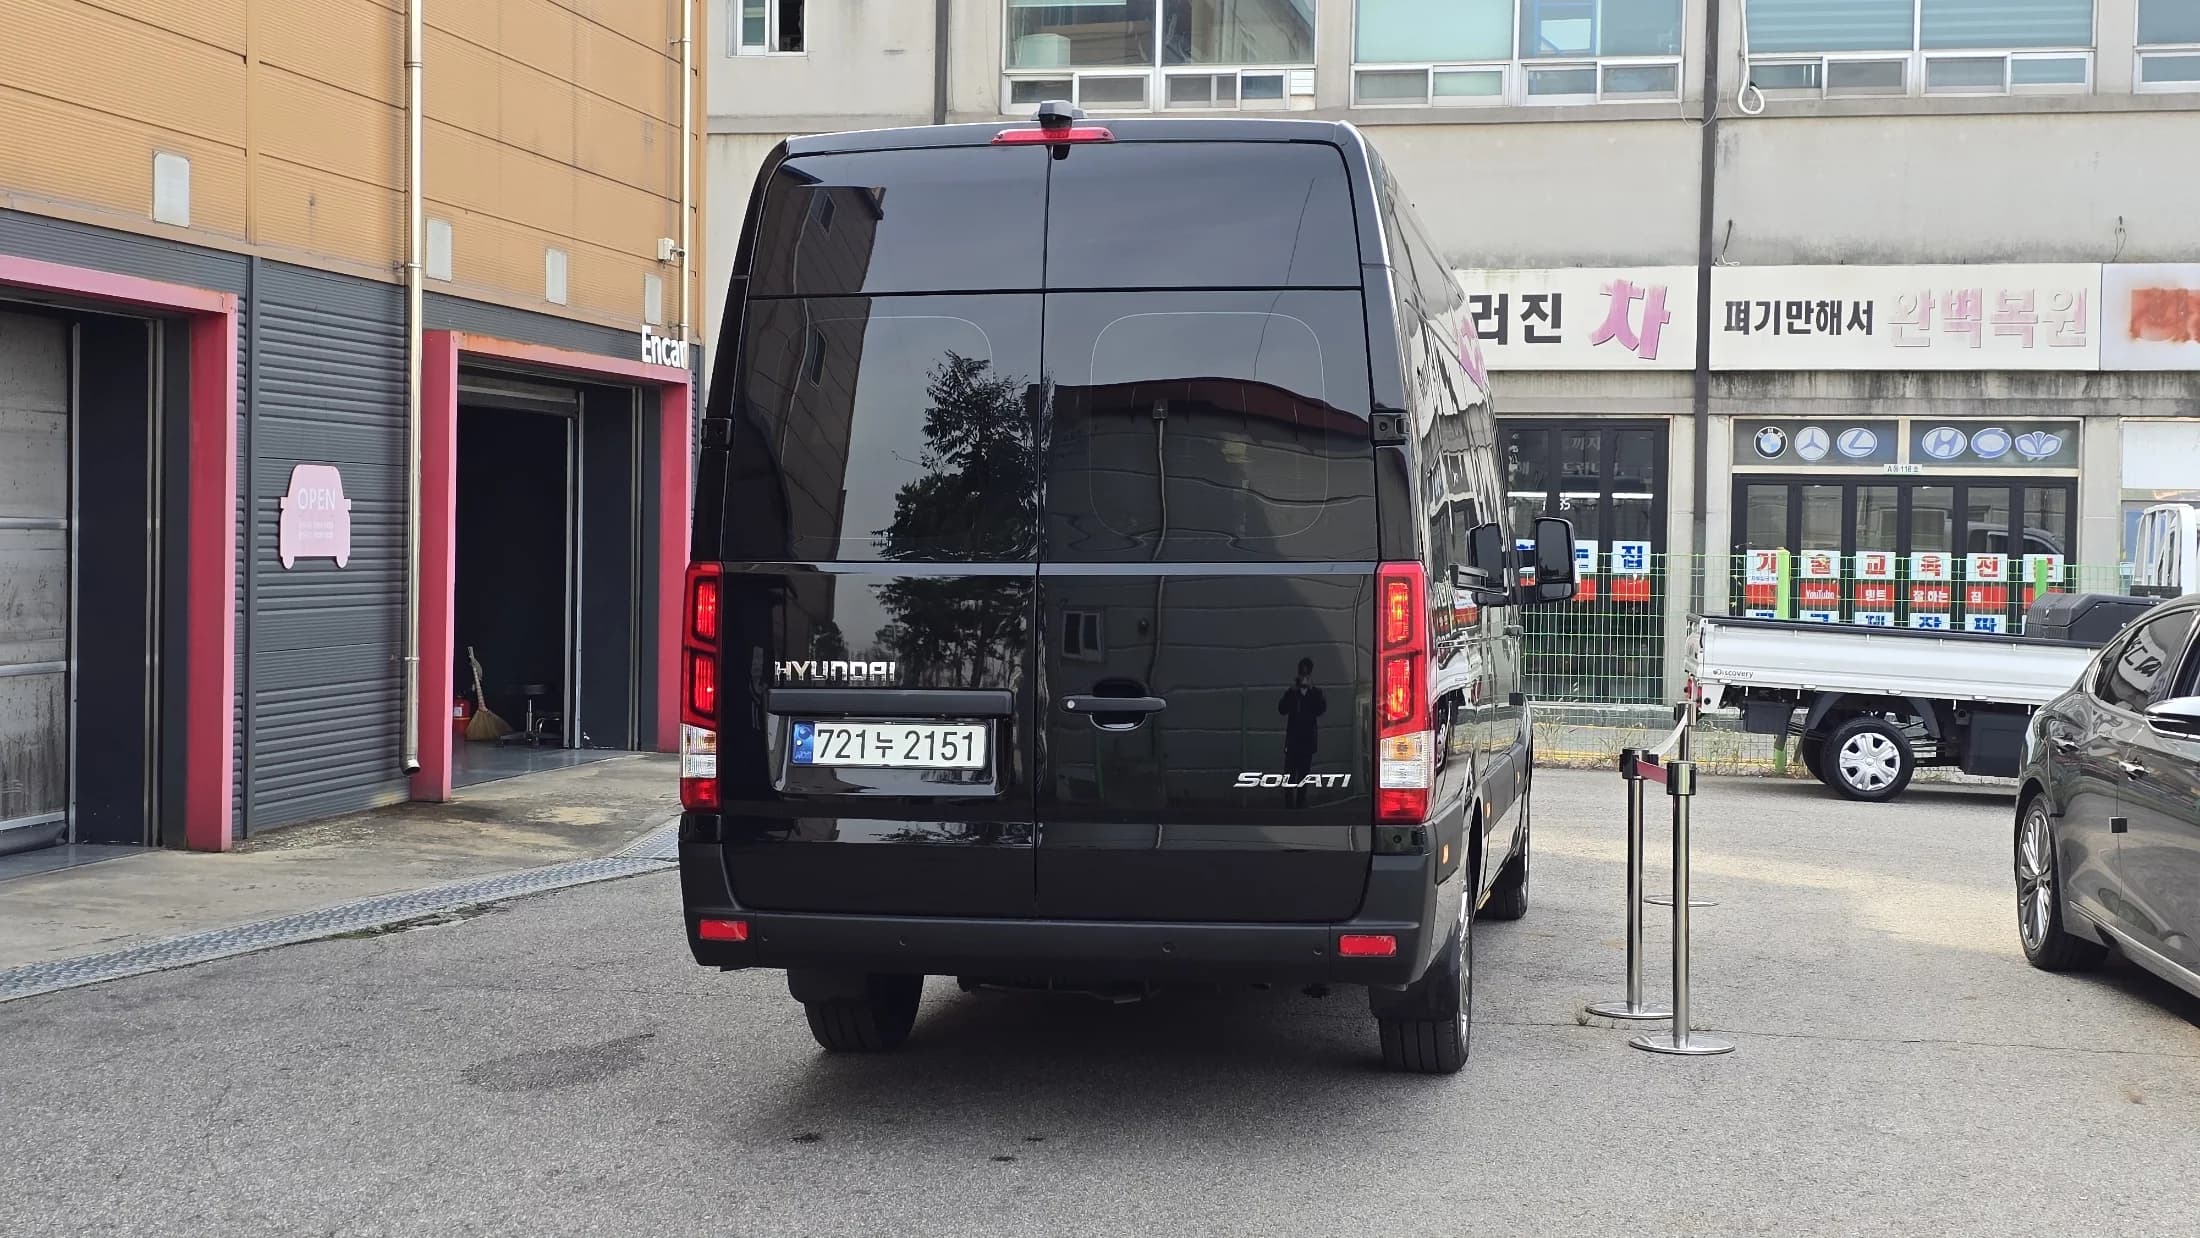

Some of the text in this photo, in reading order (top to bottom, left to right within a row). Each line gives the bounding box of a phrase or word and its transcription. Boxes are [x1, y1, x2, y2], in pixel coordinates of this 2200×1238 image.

[641, 325, 689, 370] Encar
[297, 487, 336, 511] OPEN
[774, 660, 896, 682] HYUNDAI
[903, 730, 974, 762] 2151
[1233, 771, 1352, 788] SOLATI
